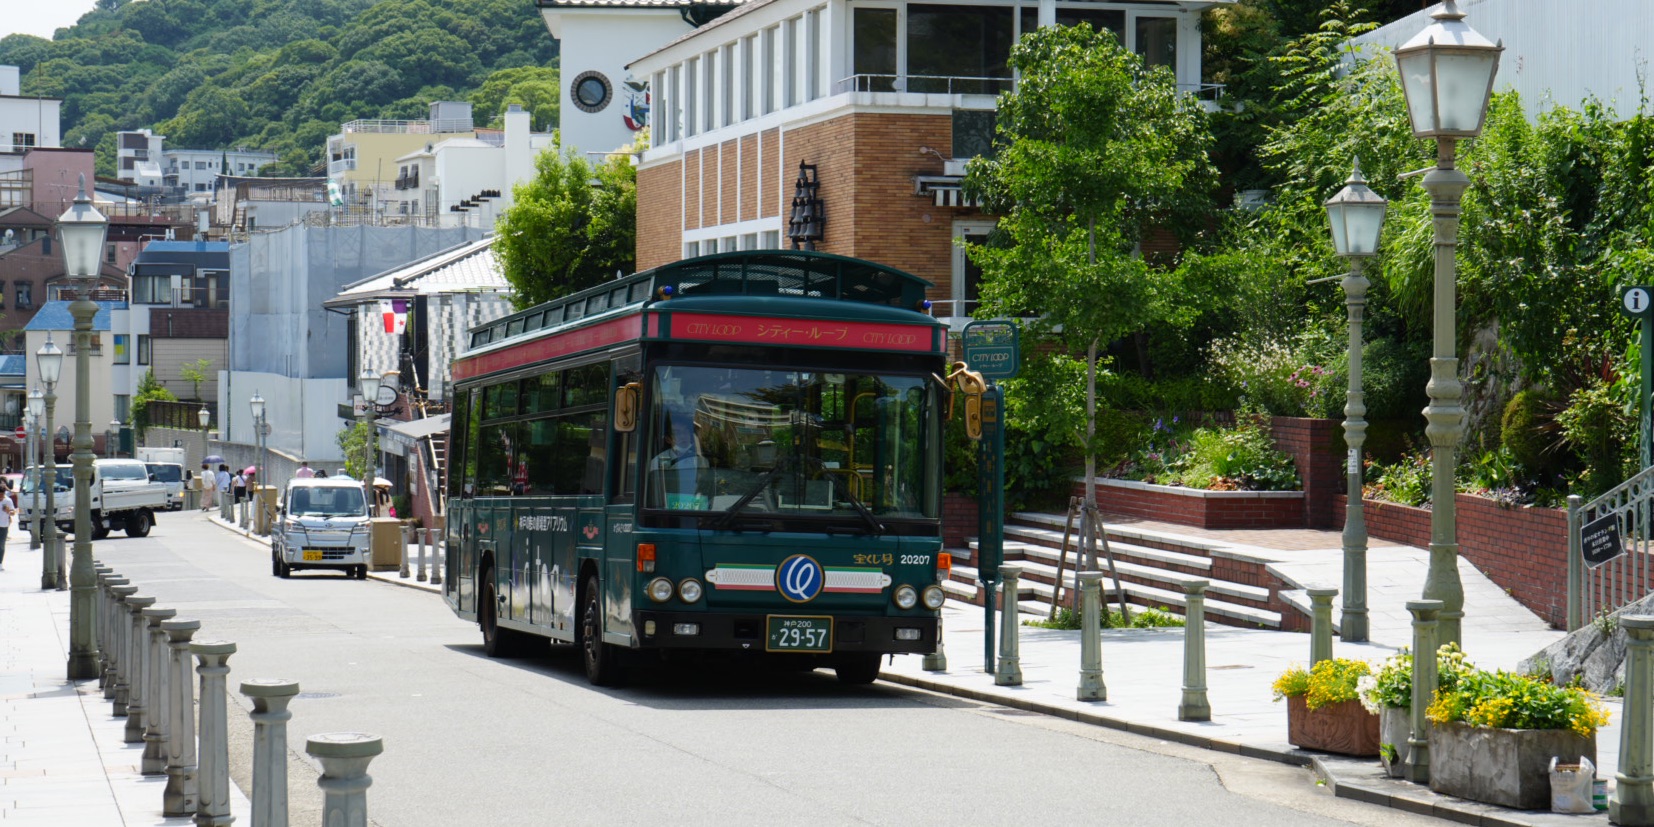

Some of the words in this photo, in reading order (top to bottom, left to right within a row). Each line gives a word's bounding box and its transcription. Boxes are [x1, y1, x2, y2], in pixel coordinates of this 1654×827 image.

[686, 322, 712, 335] CITY
[712, 323, 742, 336] LOOP
[756, 323, 849, 340] シティー・ループ
[862, 331, 886, 344] CITY
[887, 332, 917, 345] LOOP
[972, 352, 990, 362] CITY
[990, 352, 1010, 361] LOOP
[852, 553, 894, 566] 宝くじ号
[900, 554, 930, 565] 20207
[779, 628, 827, 648] 29-57
